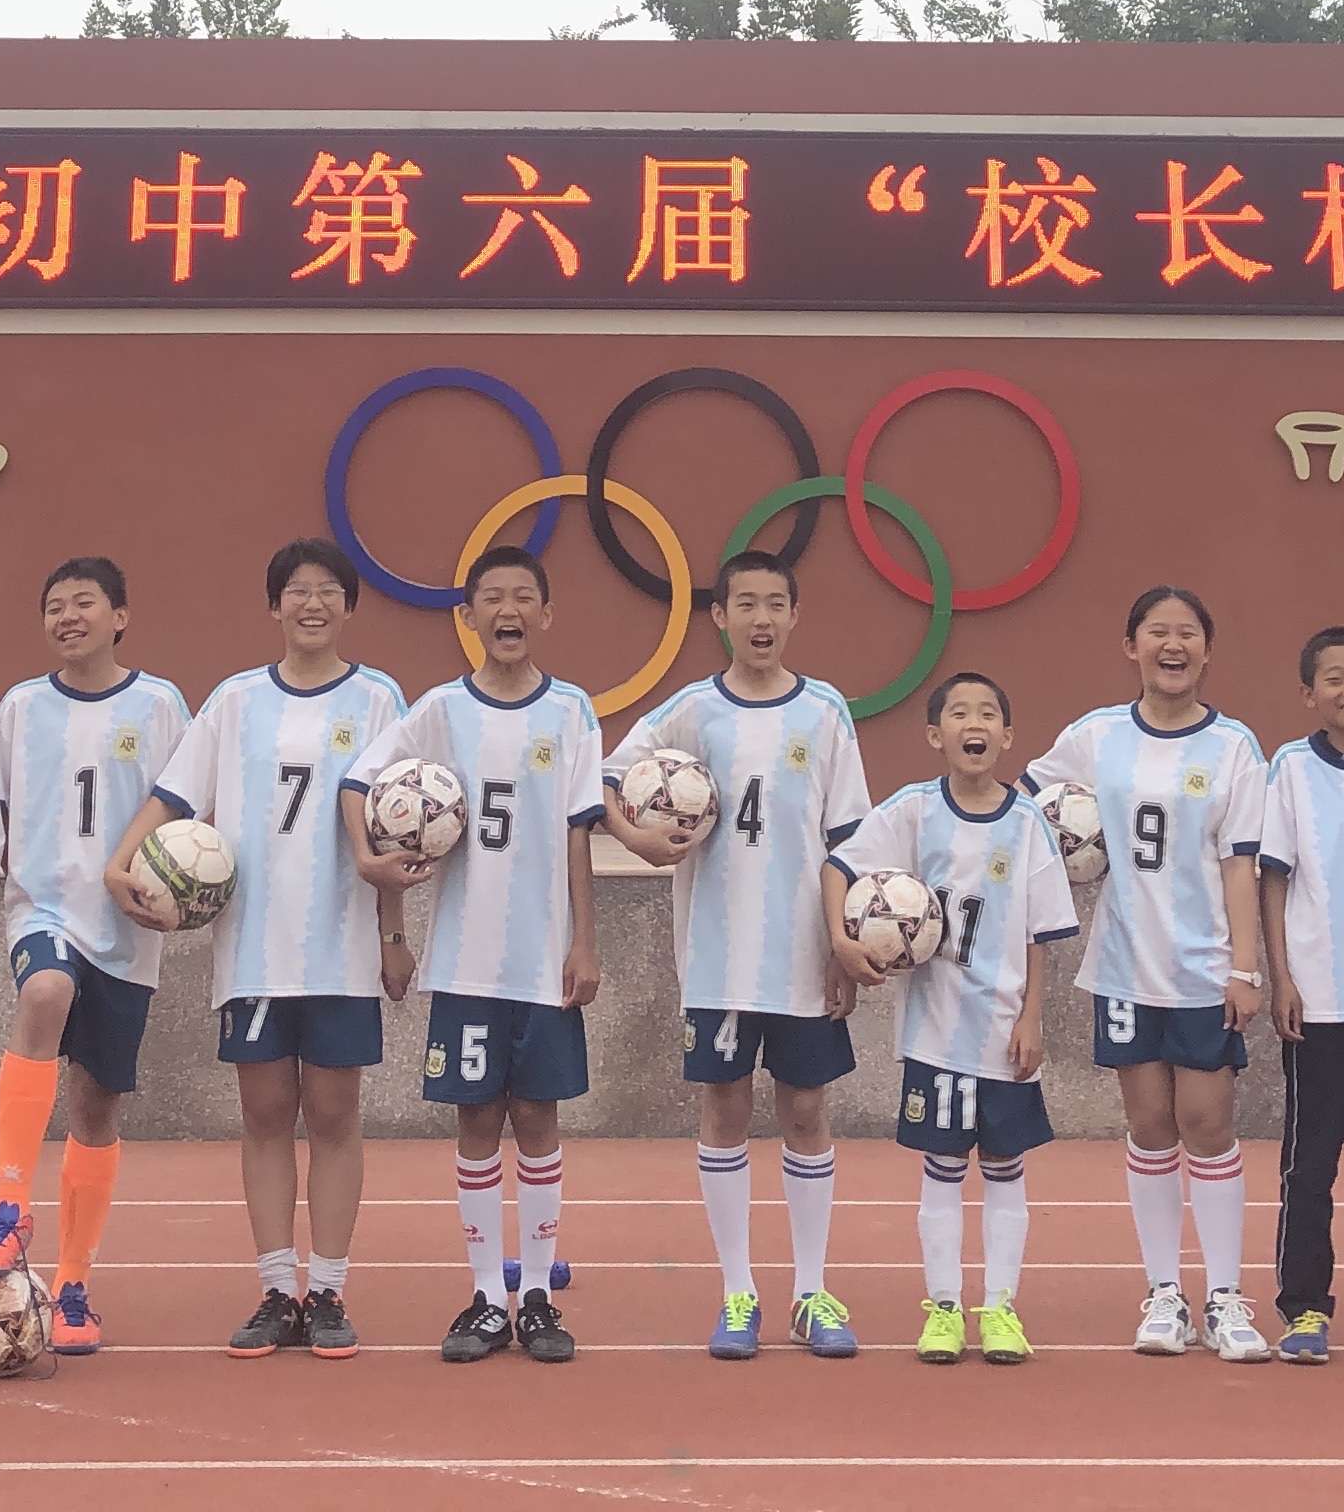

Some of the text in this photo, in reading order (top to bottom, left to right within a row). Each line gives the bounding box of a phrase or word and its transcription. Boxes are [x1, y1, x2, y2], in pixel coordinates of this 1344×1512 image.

[73, 765, 97, 837] 1
[277, 761, 314, 835] 7
[477, 777, 517, 852] 5
[733, 774, 765, 847] 4
[1131, 800, 1168, 874] 9
[459, 1024, 489, 1082] 5
[713, 1010, 739, 1062] 4
[1107, 997, 1137, 1044] 9
[933, 1072, 978, 1130] 11
